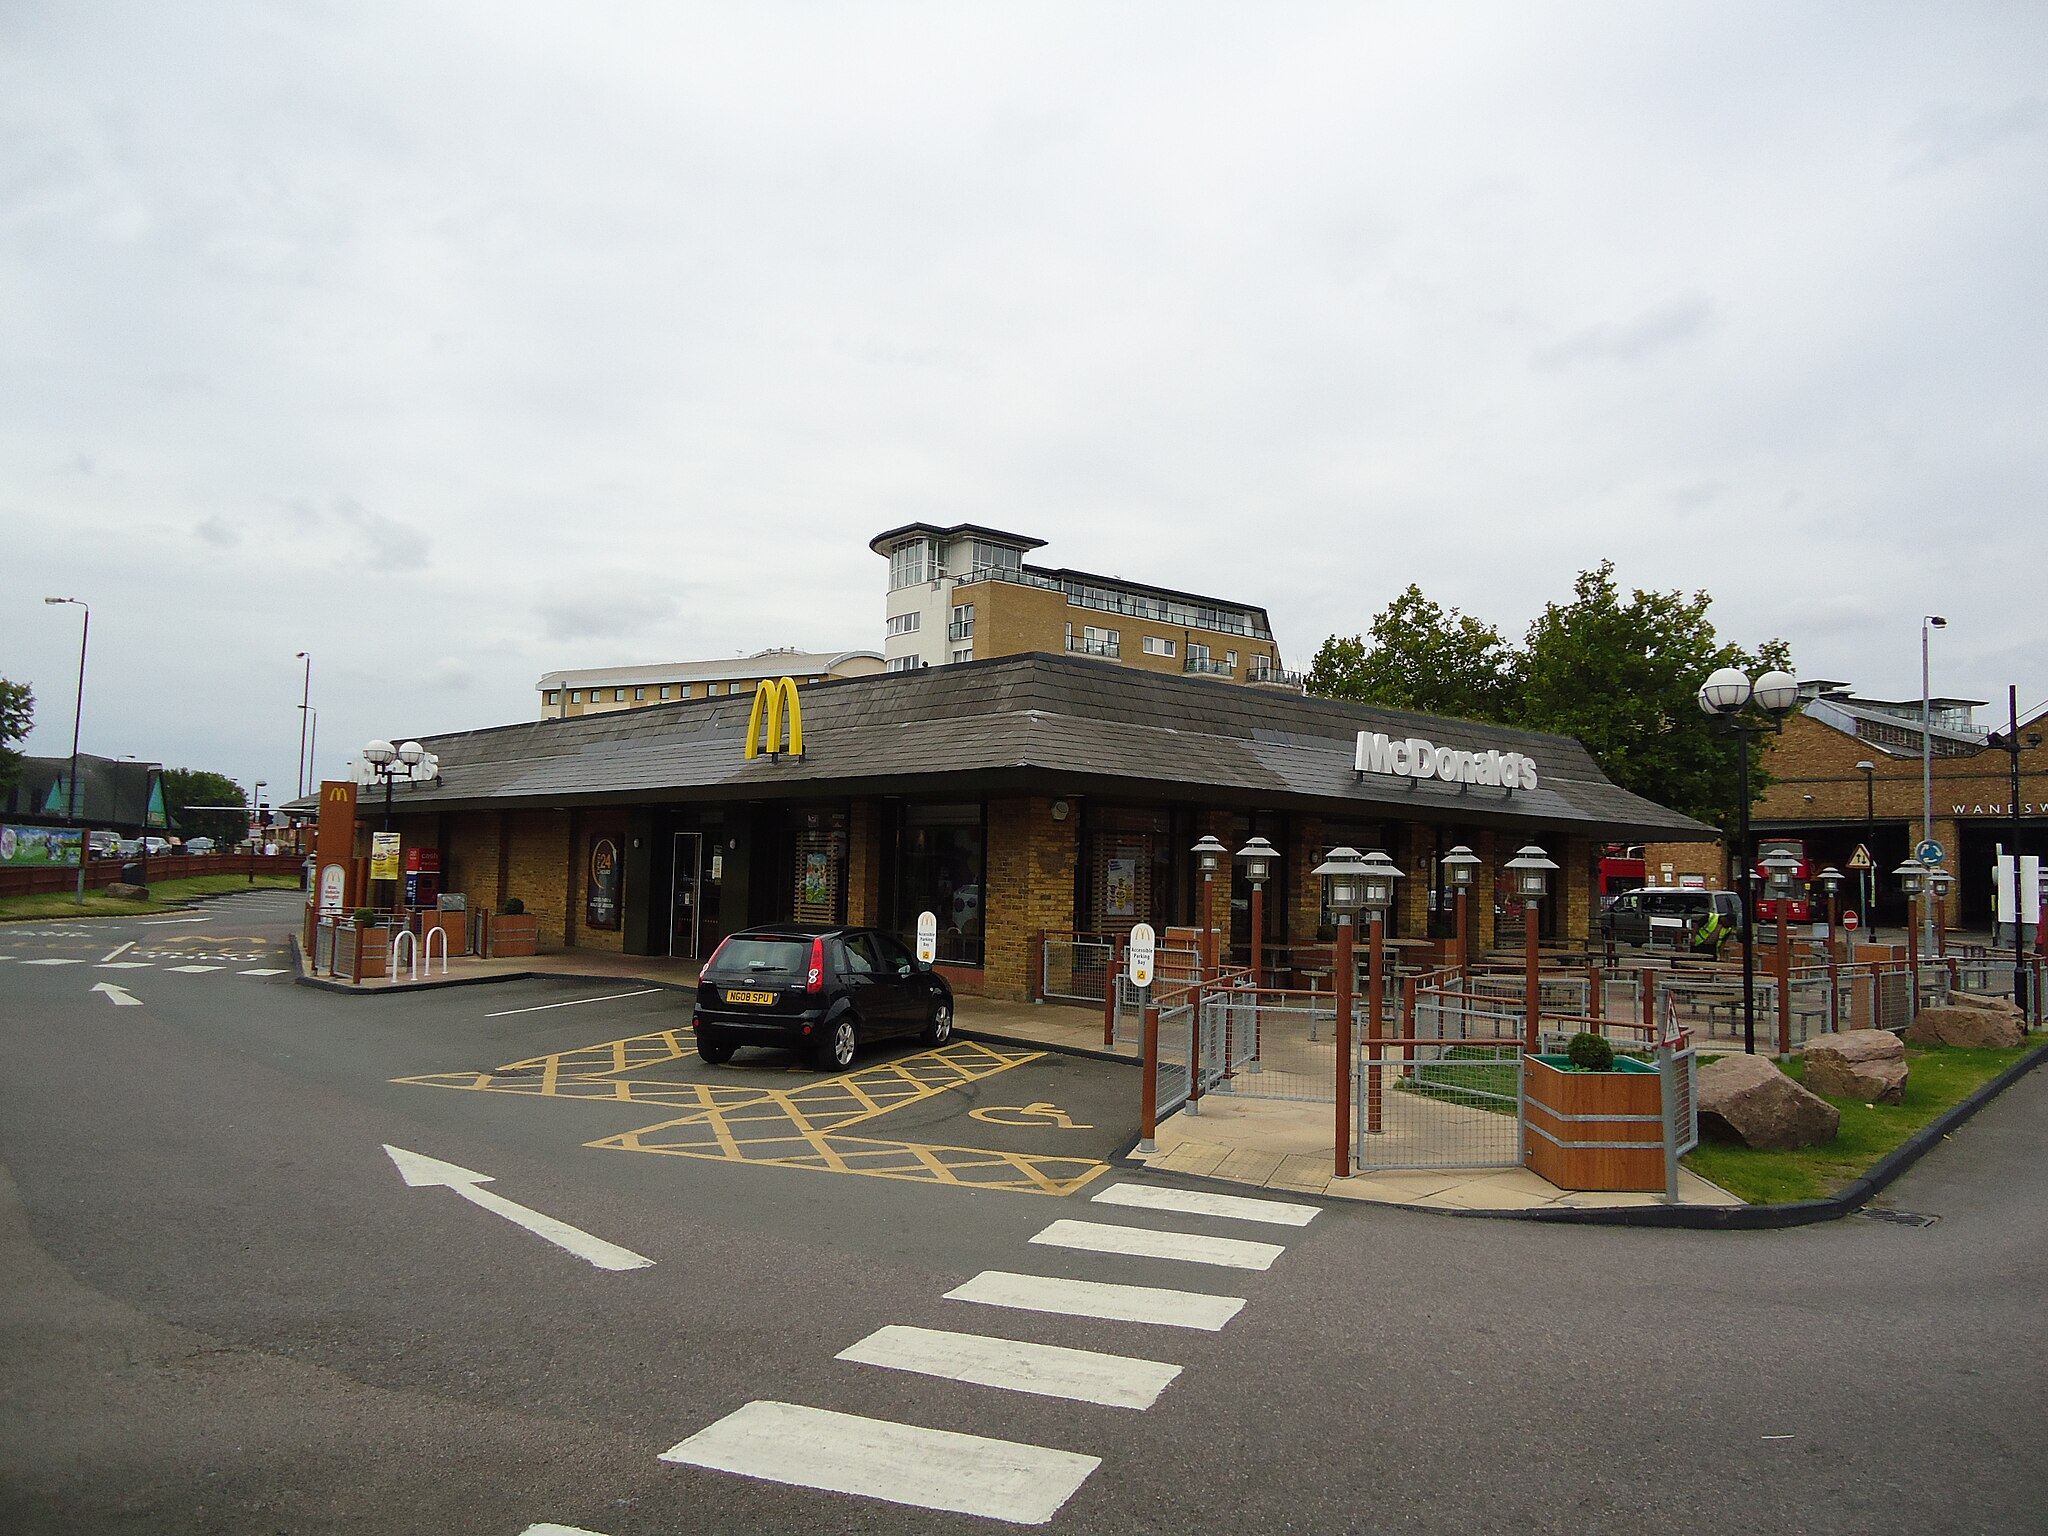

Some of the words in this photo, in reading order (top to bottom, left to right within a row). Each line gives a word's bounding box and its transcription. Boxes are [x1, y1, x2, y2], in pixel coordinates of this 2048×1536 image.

[1355, 731, 1538, 790] McDonald's
[600, 853, 611, 869] 24
[1133, 953, 1150, 961] Parking
[730, 992, 750, 1001] NG08
[752, 993, 770, 1003] SPU
